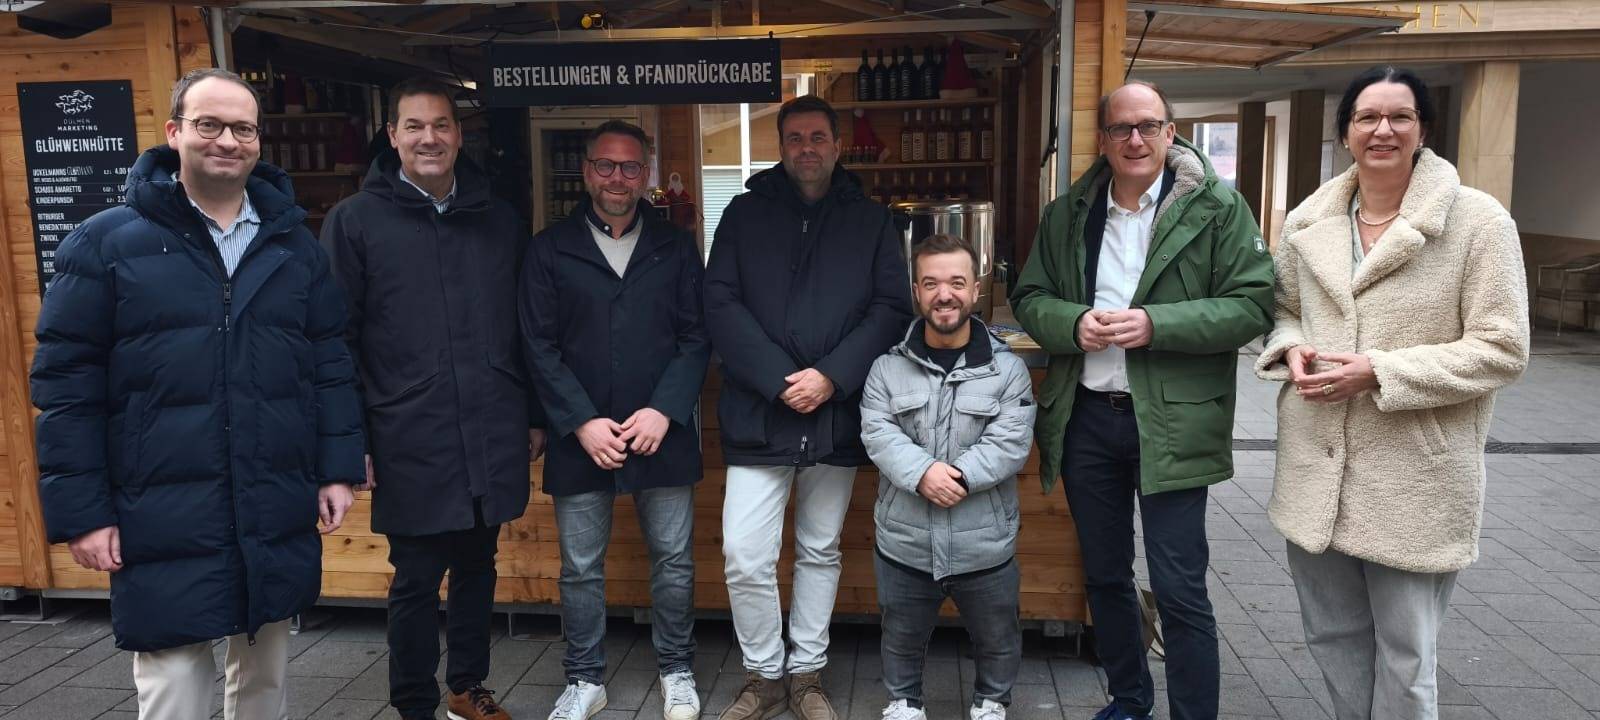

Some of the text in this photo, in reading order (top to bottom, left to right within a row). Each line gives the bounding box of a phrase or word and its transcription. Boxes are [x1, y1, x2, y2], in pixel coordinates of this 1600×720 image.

[492, 60, 772, 87] BESTELLUNGEN & PFANDRÜCKGABE
[35, 136, 125, 153] GLÜHWEINHÜTTE
[55, 185, 82, 193] AMARETTO
[36, 196, 74, 204] KINDERPUNSCH
[37, 212, 64, 220] BITBURGER
